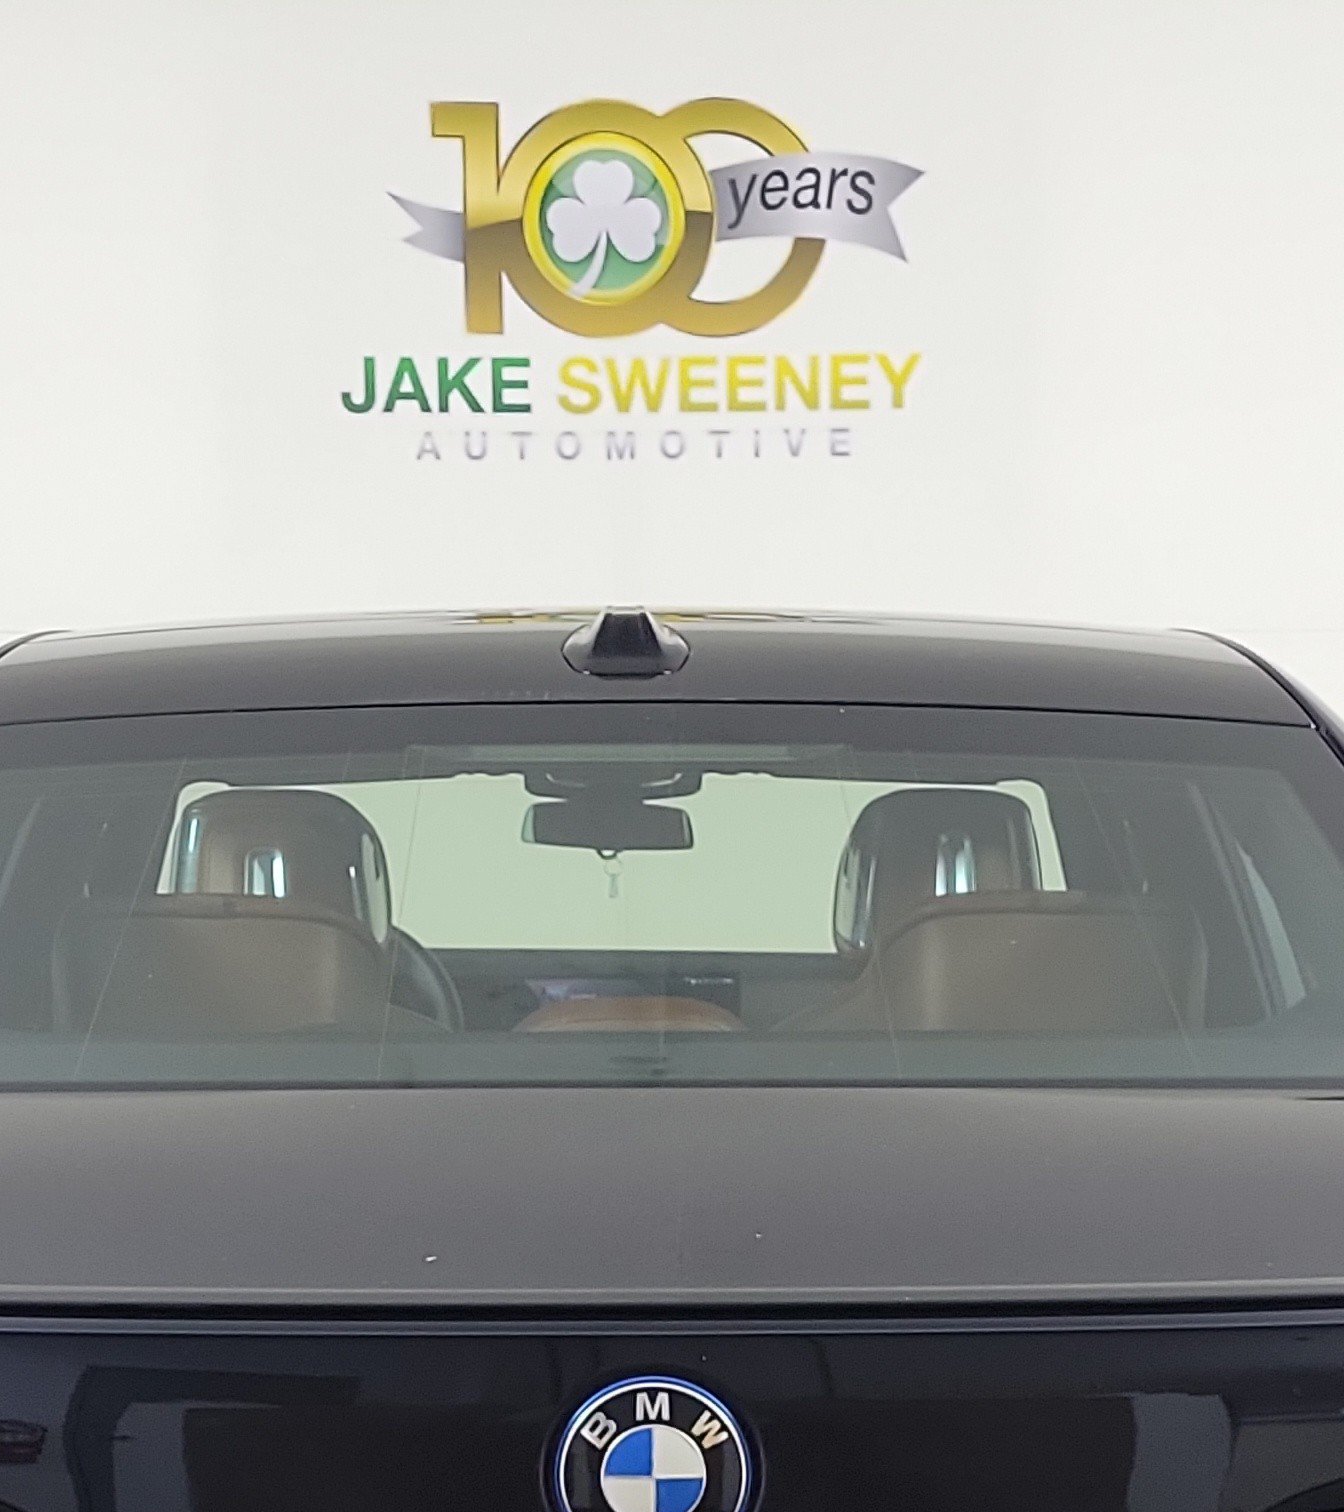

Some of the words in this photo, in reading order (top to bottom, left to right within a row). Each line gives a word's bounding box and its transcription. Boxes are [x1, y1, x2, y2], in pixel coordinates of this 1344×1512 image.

[429, 97, 826, 337] 100
[726, 163, 877, 230] years
[340, 356, 533, 415] JAKE
[556, 351, 923, 414] SWEENEY
[416, 427, 853, 461] AUTOMOTIVE
[579, 1390, 730, 1451] BMW
